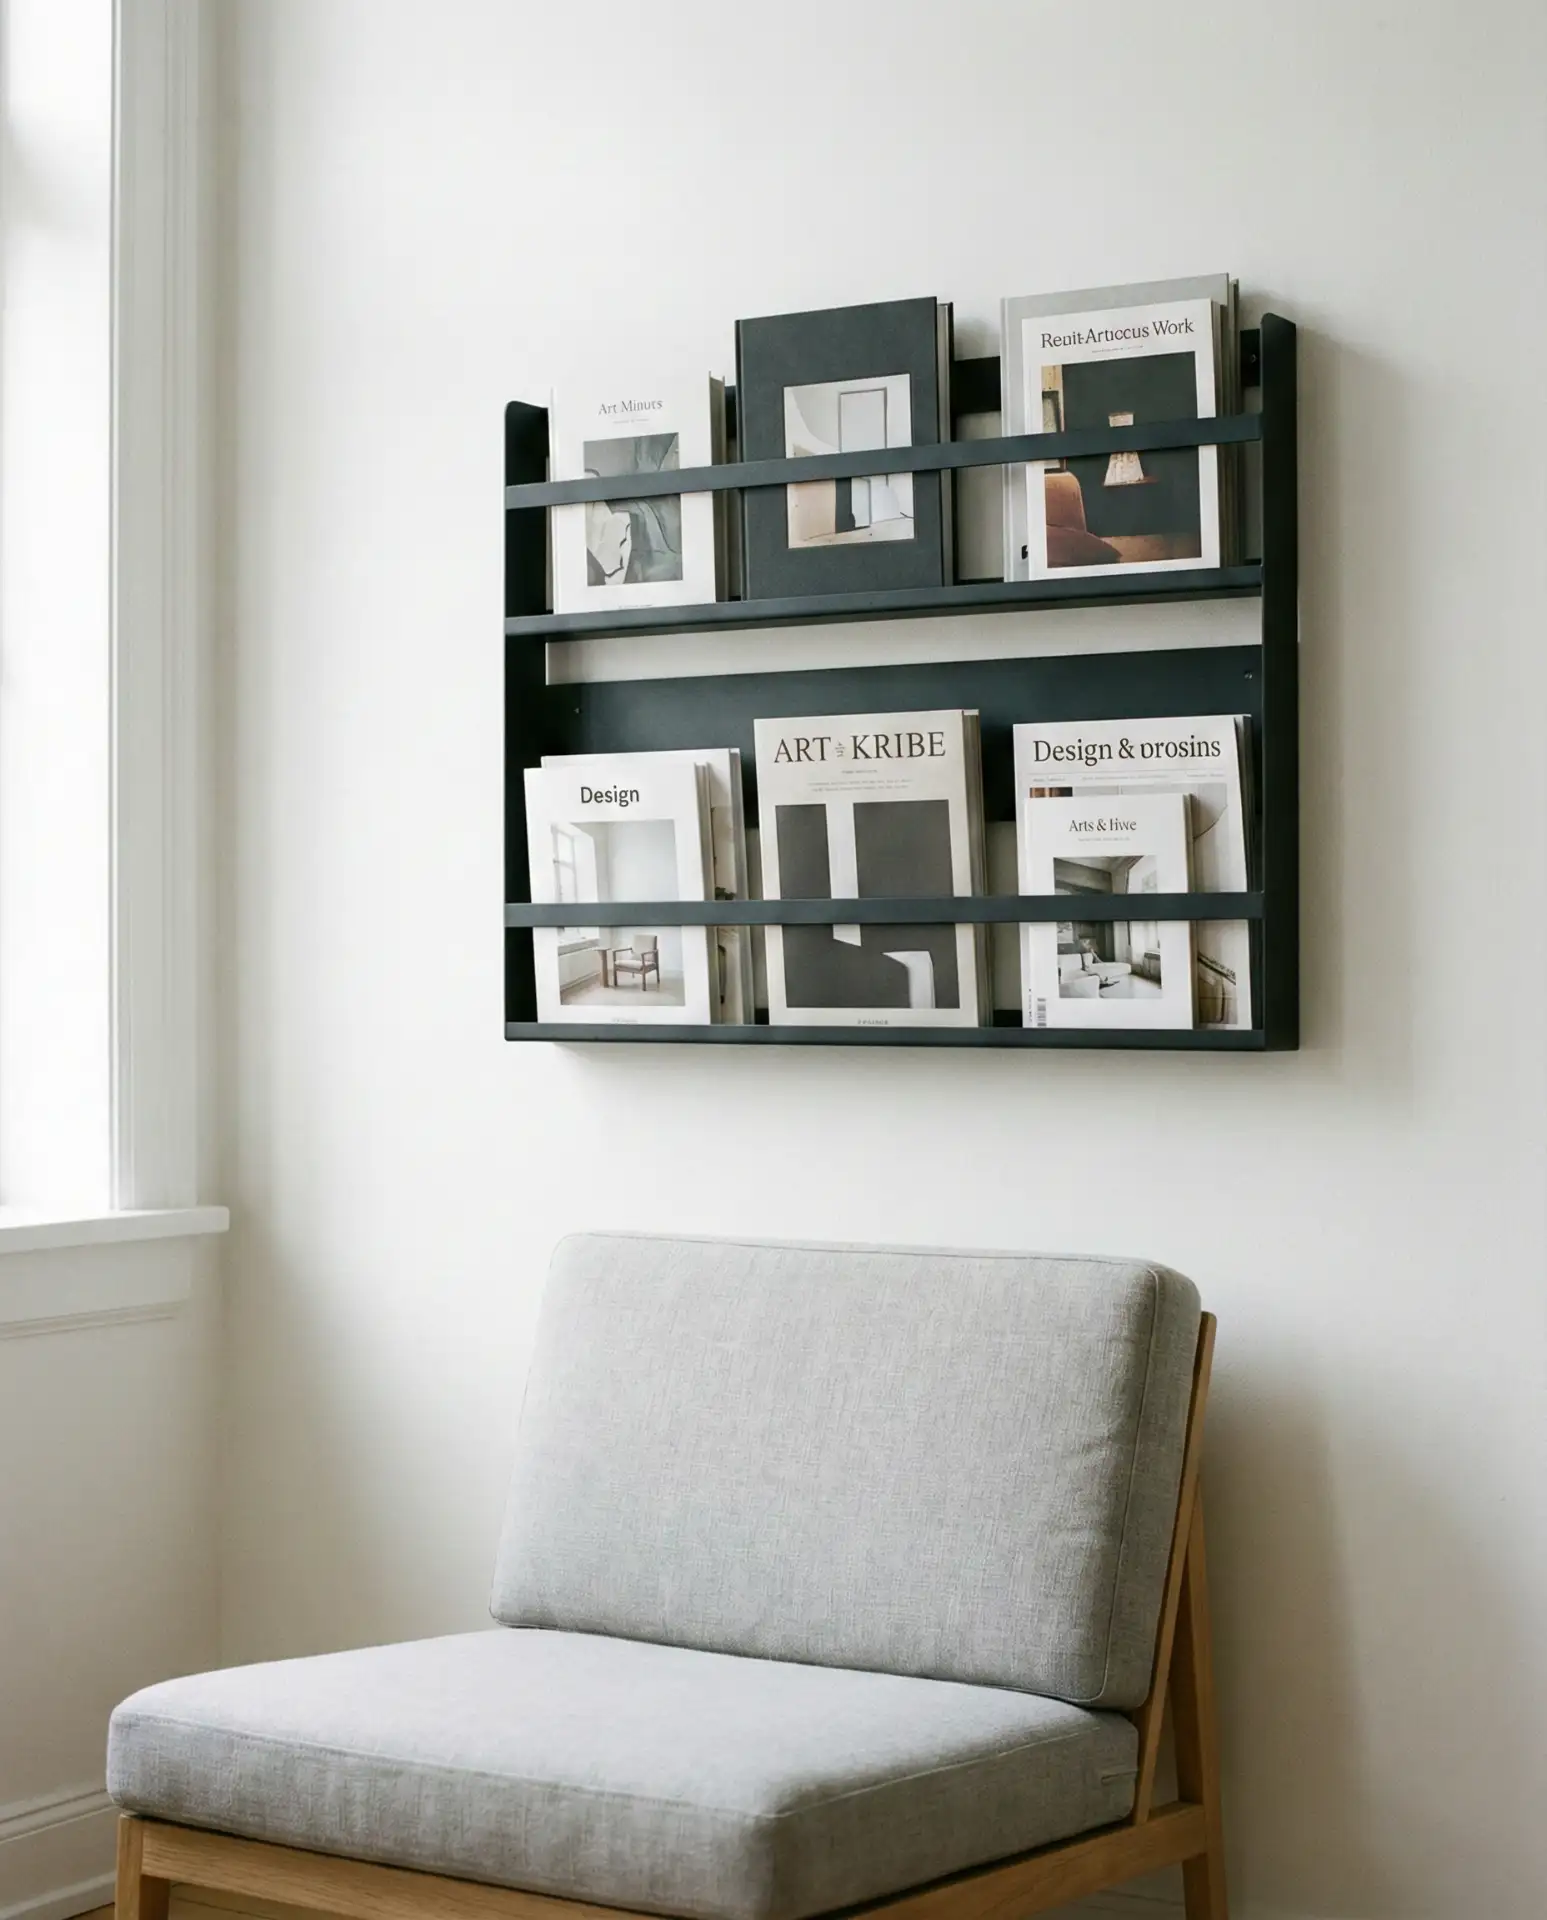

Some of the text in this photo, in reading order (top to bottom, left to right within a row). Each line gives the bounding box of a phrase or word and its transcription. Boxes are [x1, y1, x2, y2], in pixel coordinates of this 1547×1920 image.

[1152, 317, 1195, 336] Work
[598, 403, 618, 415] Art
[773, 736, 832, 763] ART
[851, 731, 947, 760] KRIBE
[1033, 738, 1113, 767] Design
[1118, 737, 1136, 760] &
[580, 784, 640, 808] Design
[1069, 819, 1095, 832] Arts
[1096, 818, 1107, 832] &
